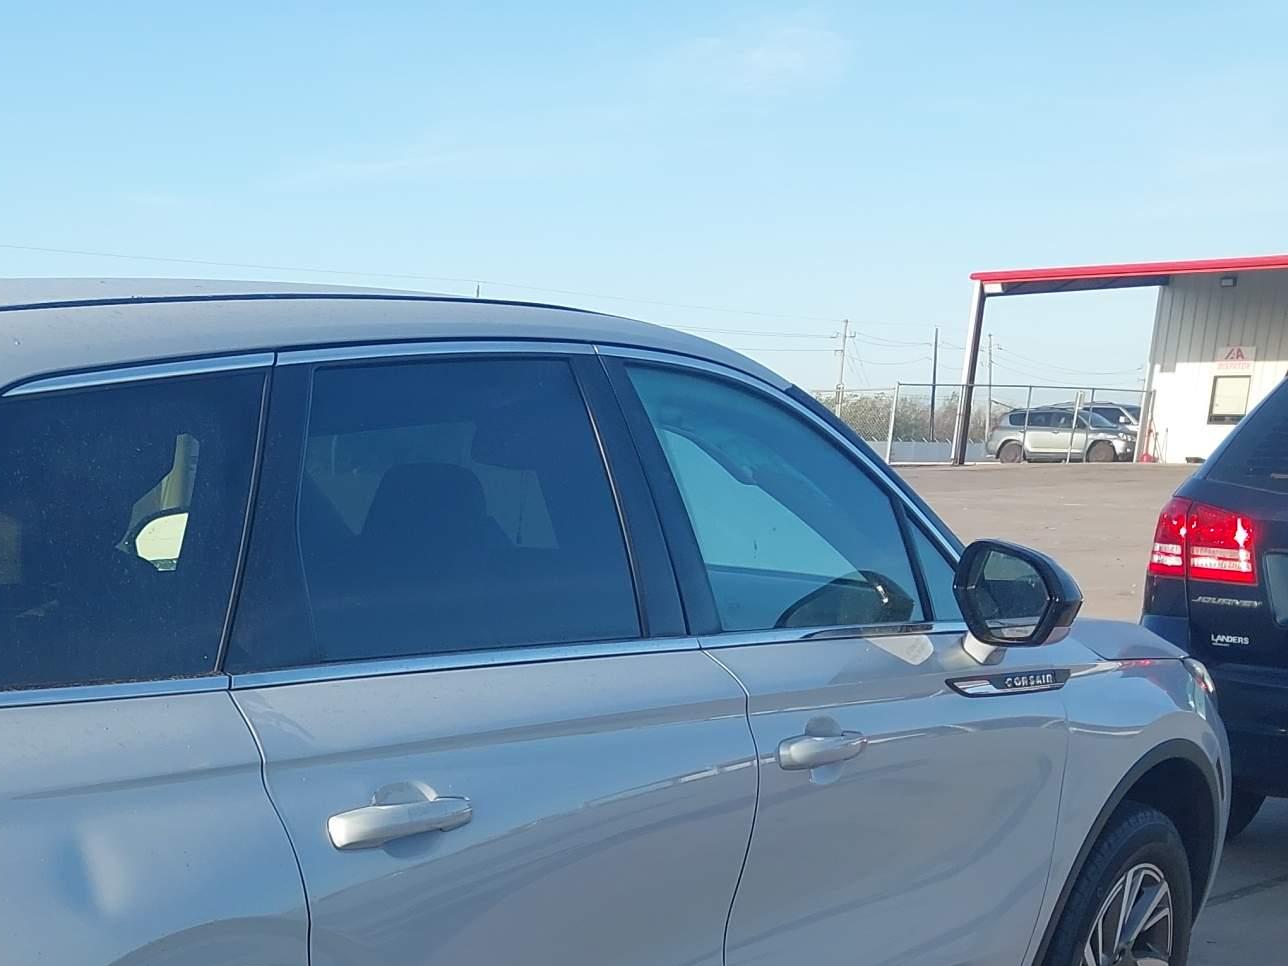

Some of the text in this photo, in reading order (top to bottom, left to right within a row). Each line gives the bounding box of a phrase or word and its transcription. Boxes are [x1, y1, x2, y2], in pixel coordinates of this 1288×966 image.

[1191, 595, 1263, 608] JOURNEY
[1211, 634, 1250, 645] LANDERS
[1005, 673, 1053, 687] CORSAIR
